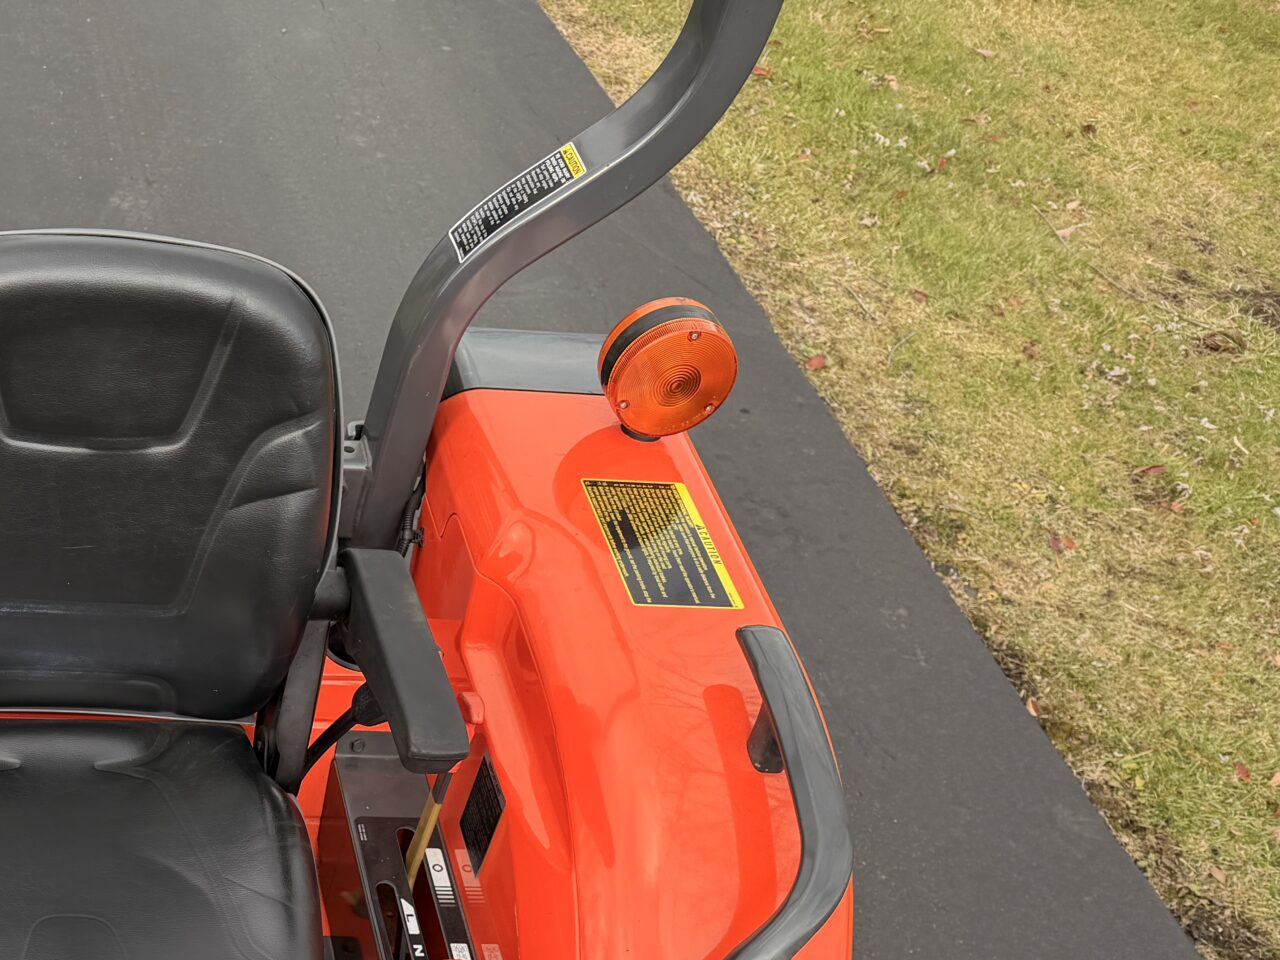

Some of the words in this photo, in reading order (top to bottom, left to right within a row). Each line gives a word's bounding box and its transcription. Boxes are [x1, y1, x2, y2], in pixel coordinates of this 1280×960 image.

[564, 151, 581, 175] CAUTION
[699, 531, 722, 564] CAUTION
[406, 914, 414, 922] L
[413, 945, 424, 956] N
